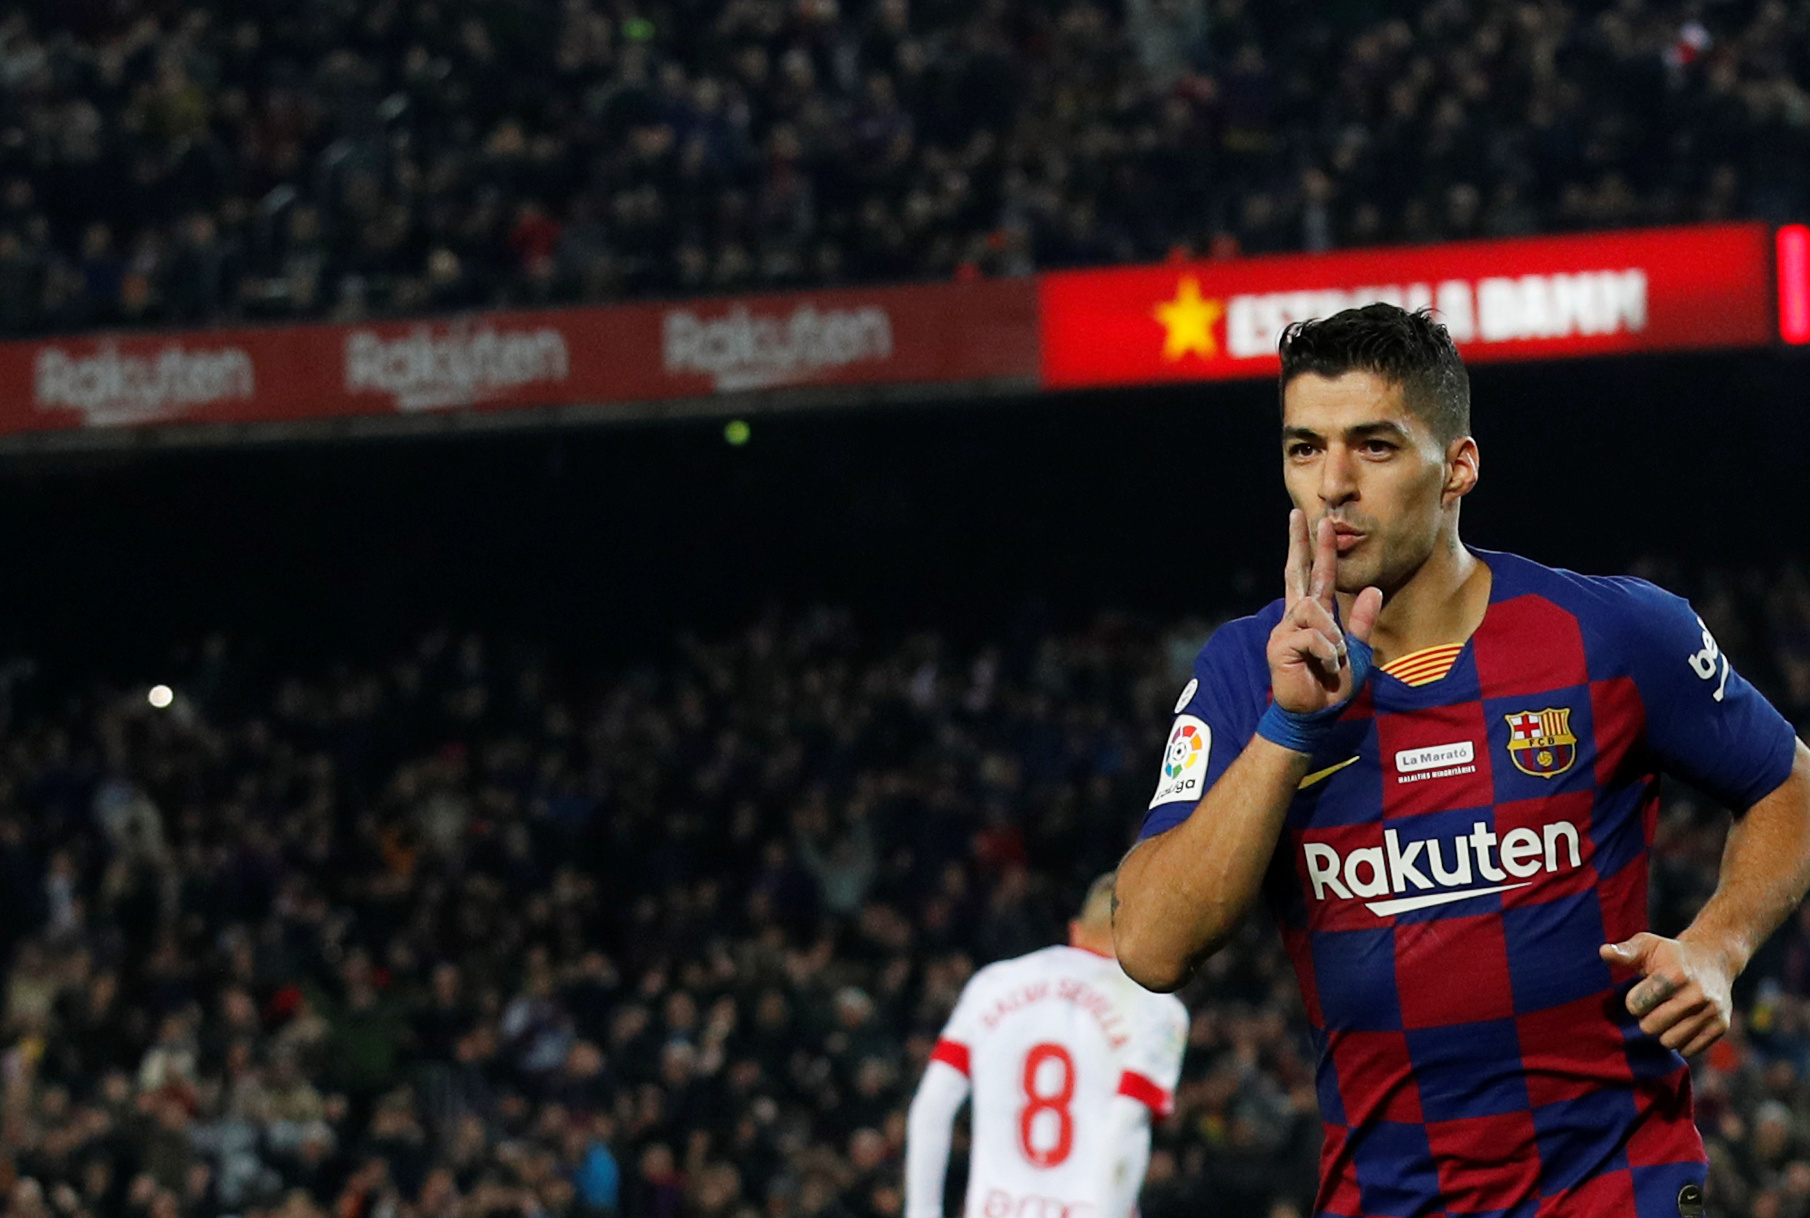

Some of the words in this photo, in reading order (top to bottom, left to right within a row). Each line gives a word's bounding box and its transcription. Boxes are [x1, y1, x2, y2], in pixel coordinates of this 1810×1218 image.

[661, 304, 893, 374] Rakuten
[1476, 268, 1648, 342] DAMM
[34, 345, 255, 407] Rakuten
[344, 325, 570, 394] Rakuten
[1402, 757, 1418, 766] La
[1420, 748, 1467, 763] Marató
[1304, 821, 1582, 900] Rakuten
[1017, 1041, 1077, 1170] 8
